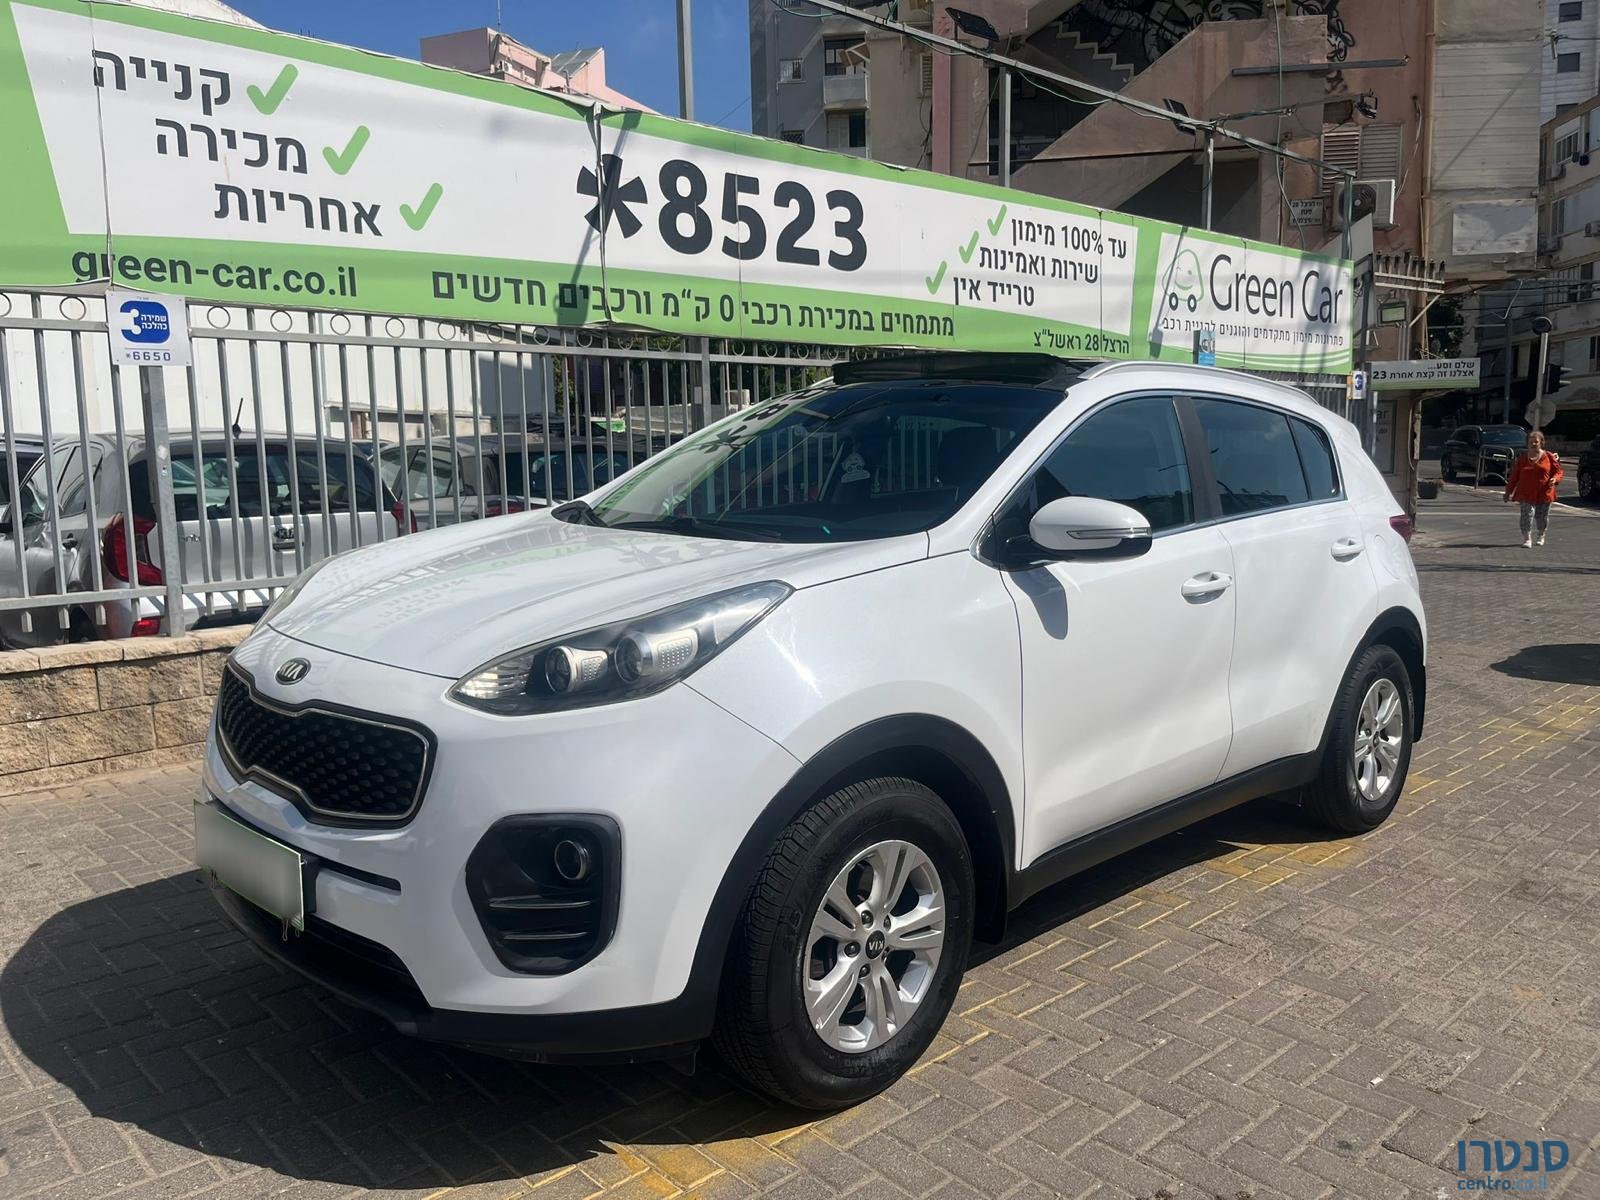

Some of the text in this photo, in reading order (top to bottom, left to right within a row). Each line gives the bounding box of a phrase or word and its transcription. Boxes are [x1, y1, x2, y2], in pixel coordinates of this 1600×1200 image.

[92, 49, 231, 116] קנייה
[155, 118, 308, 175] מכירה
[214, 183, 383, 236] אחריות
[1011, 218, 1127, 259] עד 100% מימון
[72, 249, 358, 297] green-car.co.il
[979, 247, 1098, 283] שירות ואמינות
[432, 271, 547, 307] חדשים
[558, 283, 652, 315] ורכבים
[953, 276, 1035, 306] טרייד אין
[1210, 254, 1343, 324] Green Car
[140, 314, 167, 322] שמירה
[719, 294, 734, 322] 0
[741, 300, 792, 326] רכבי
[799, 305, 875, 332] במכירת
[141, 322, 168, 330] כהלכה
[881, 311, 954, 337] מתמחים
[1163, 317, 1182, 331] רכב
[1220, 323, 1251, 338] והוגנים
[1254, 327, 1290, 343] מתקדמים
[1034, 329, 1130, 354] הרצל 28 ראשל"צ
[1293, 330, 1313, 345] מימון
[1373, 369, 1474, 379] אצלנו זה קצת אחרת 23
[1454, 361, 1475, 369] שלם
[279, 661, 304, 680] KIA
